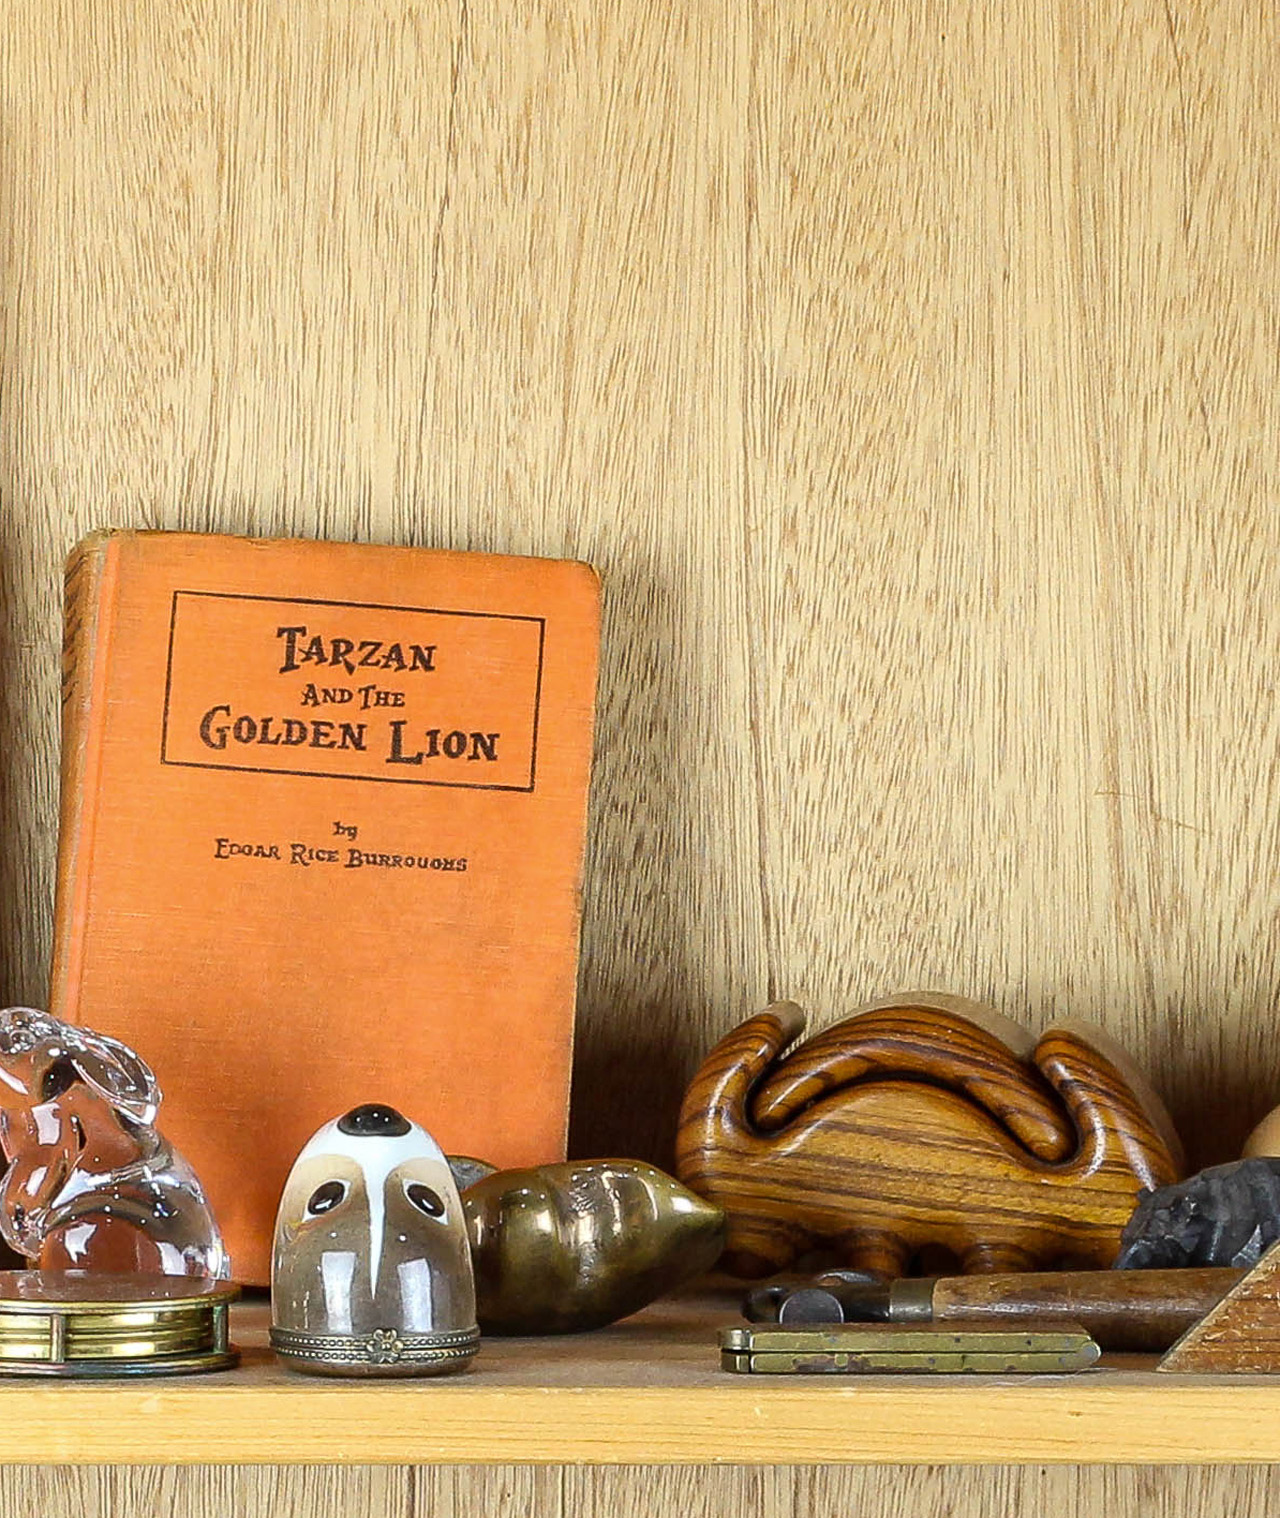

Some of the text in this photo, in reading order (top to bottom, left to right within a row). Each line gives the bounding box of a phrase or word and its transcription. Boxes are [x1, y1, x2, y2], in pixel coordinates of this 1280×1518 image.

[276, 626, 438, 675] TARZAN
[301, 683, 406, 710] AND THE
[200, 705, 501, 765] GOLDEN LION
[332, 821, 358, 841] by
[214, 838, 469, 872] EDGAR RICE BURROUGHS
